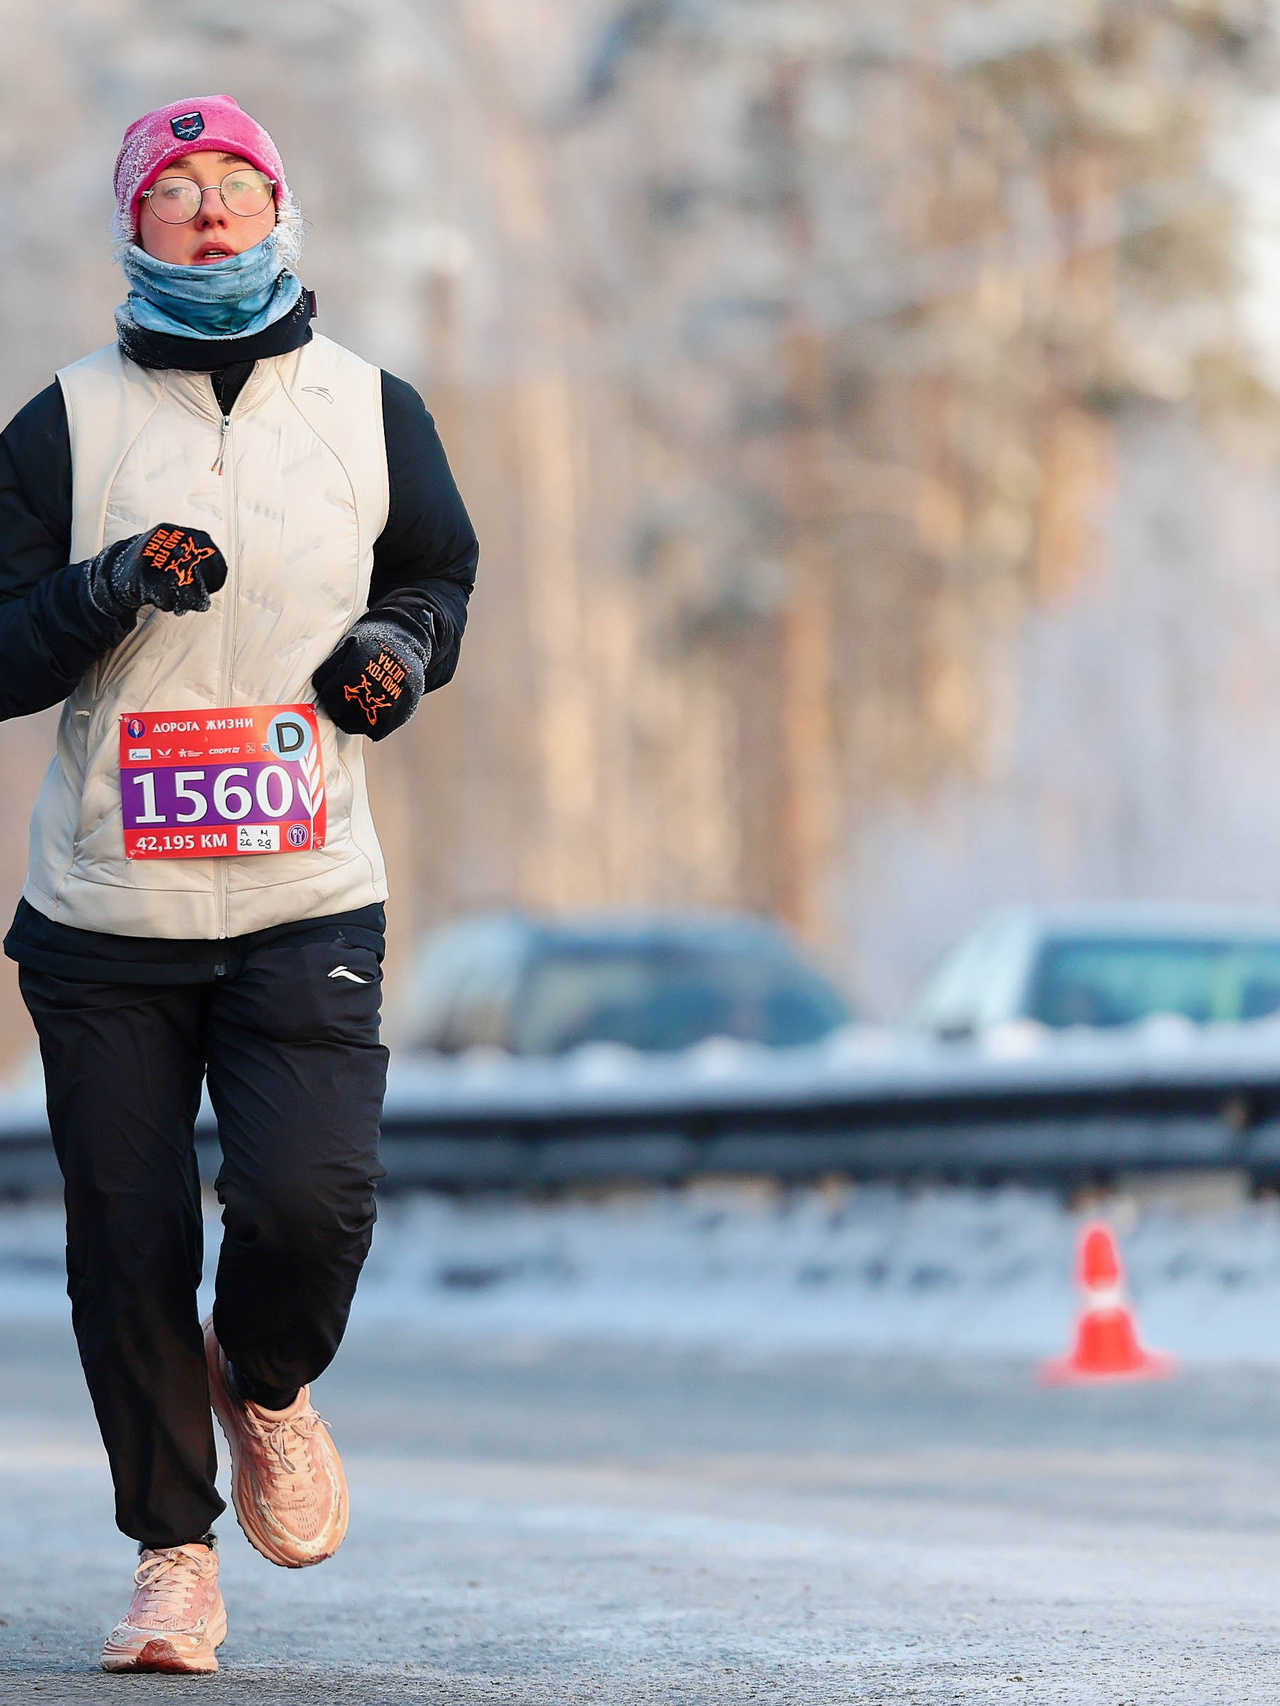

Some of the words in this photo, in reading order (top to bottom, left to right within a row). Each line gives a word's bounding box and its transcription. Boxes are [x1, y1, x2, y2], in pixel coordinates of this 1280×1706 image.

[142, 529, 170, 557] ULTRA
[163, 530, 186, 549] MAD
[150, 548, 170, 569] FOX
[365, 659, 386, 682] FOX
[378, 652, 406, 684] ULTRA
[382, 675, 402, 700] MAD
[153, 720, 200, 733] ДОРОГА
[205, 717, 254, 731] ЖИЗНИ
[276, 722, 305, 753] D
[132, 765, 294, 824] 1560
[136, 834, 195, 852] 42,195
[201, 833, 228, 849] КМ
